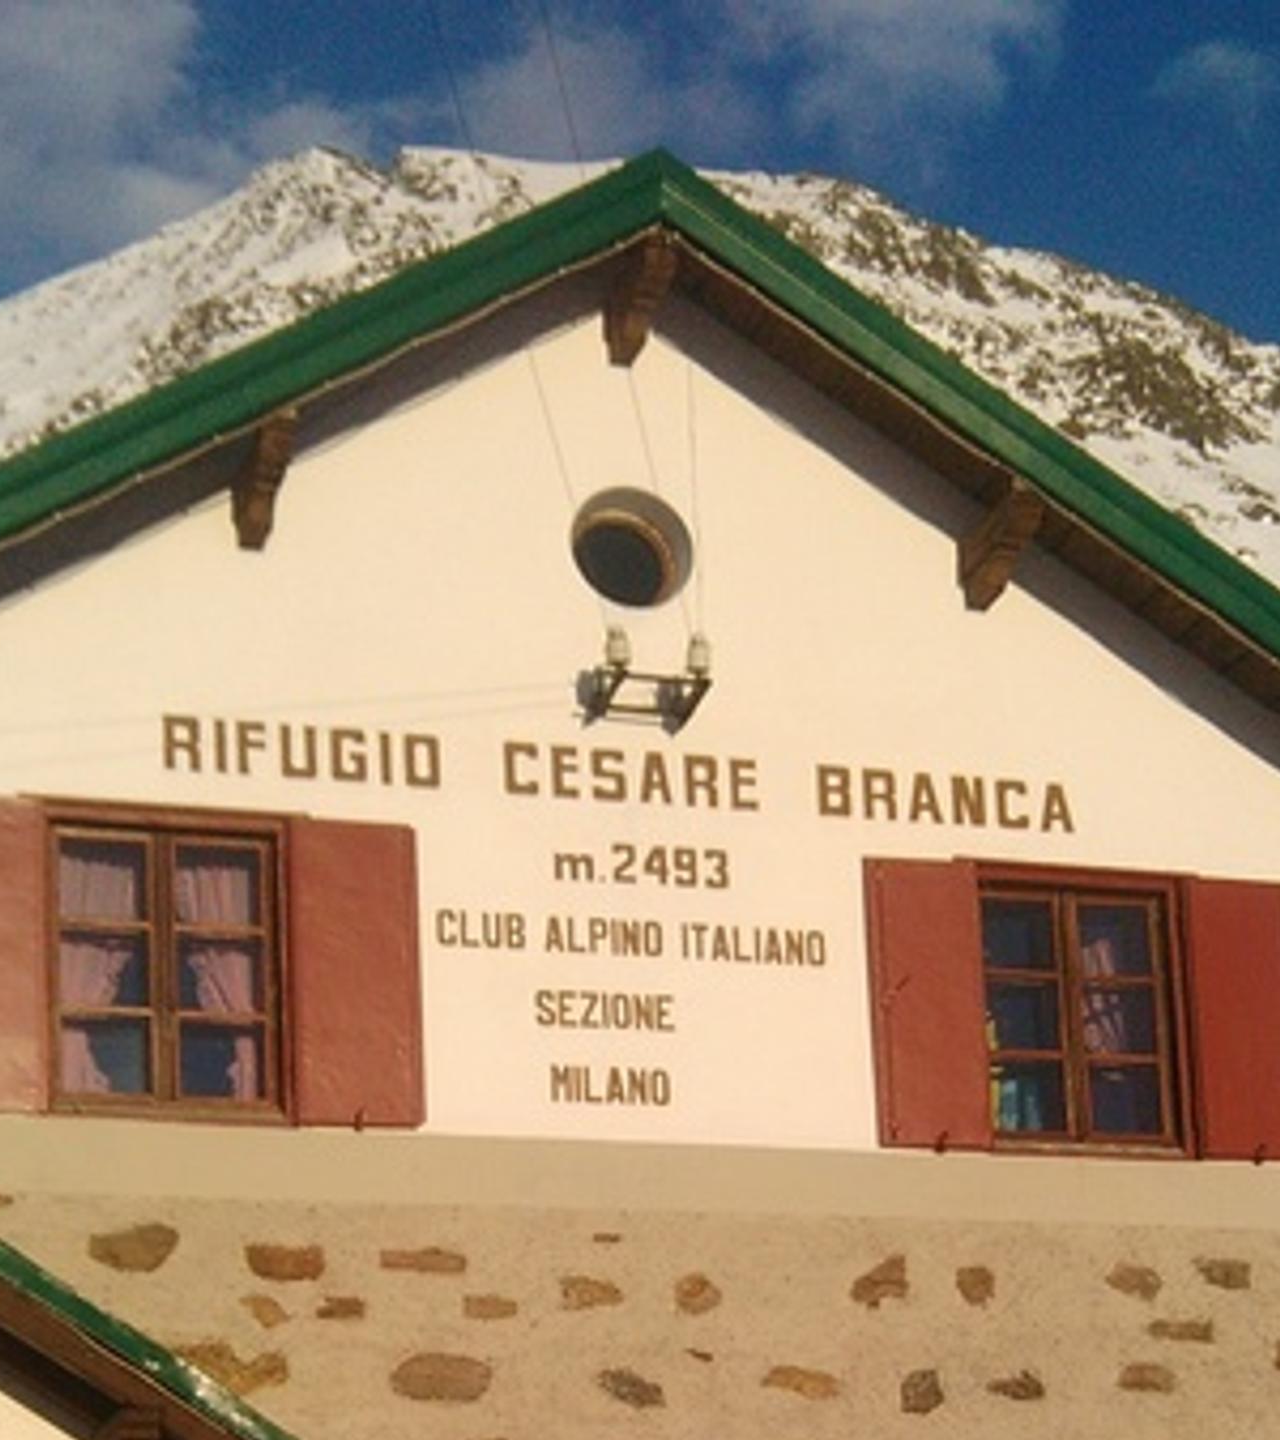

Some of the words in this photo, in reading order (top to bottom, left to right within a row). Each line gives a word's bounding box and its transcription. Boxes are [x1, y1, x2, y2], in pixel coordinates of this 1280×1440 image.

[163, 715, 441, 789] RIFUGIO
[504, 742, 759, 811] CESARE
[817, 765, 1075, 834] BRANCA
[554, 844, 729, 889] m.2493
[437, 910, 526, 949] CLUB
[545, 917, 663, 957] ALPINO
[682, 924, 826, 967] ITALIANO
[536, 990, 675, 1031] SEZIONE
[551, 1066, 671, 1107] MILANO
